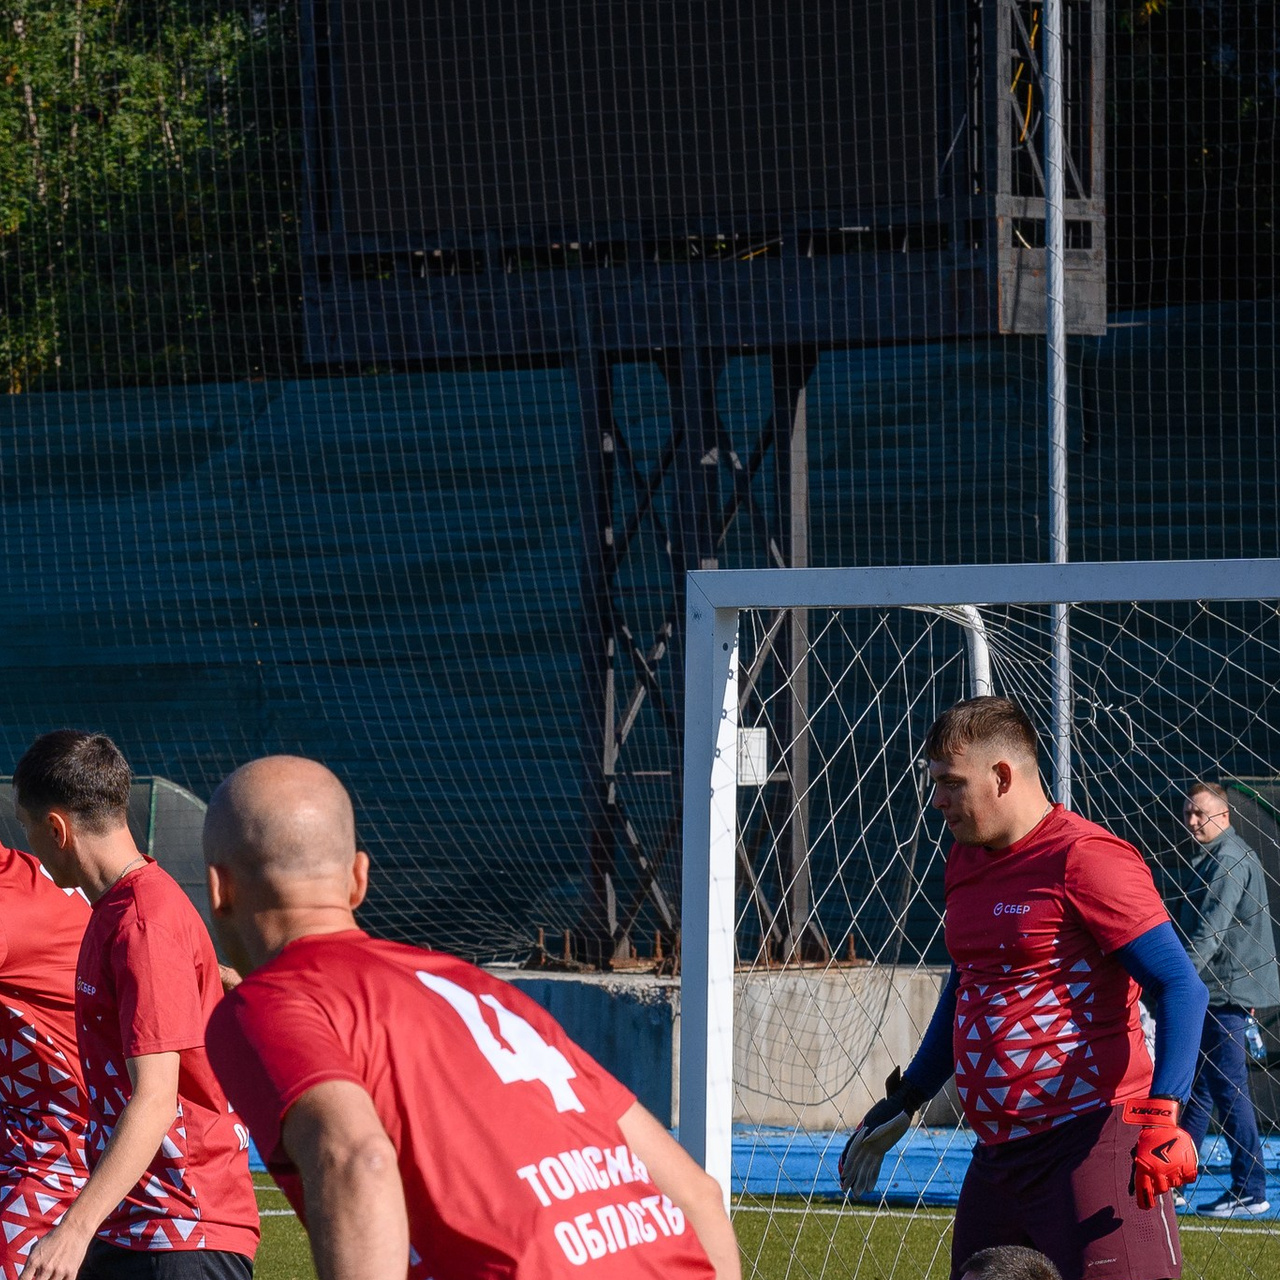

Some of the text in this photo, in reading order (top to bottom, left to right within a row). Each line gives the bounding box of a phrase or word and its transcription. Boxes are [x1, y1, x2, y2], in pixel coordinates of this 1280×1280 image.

[1004, 904, 1031, 915] СБЕР
[415, 970, 586, 1113] 4
[553, 1193, 686, 1266] ОБЛАСТЬ
